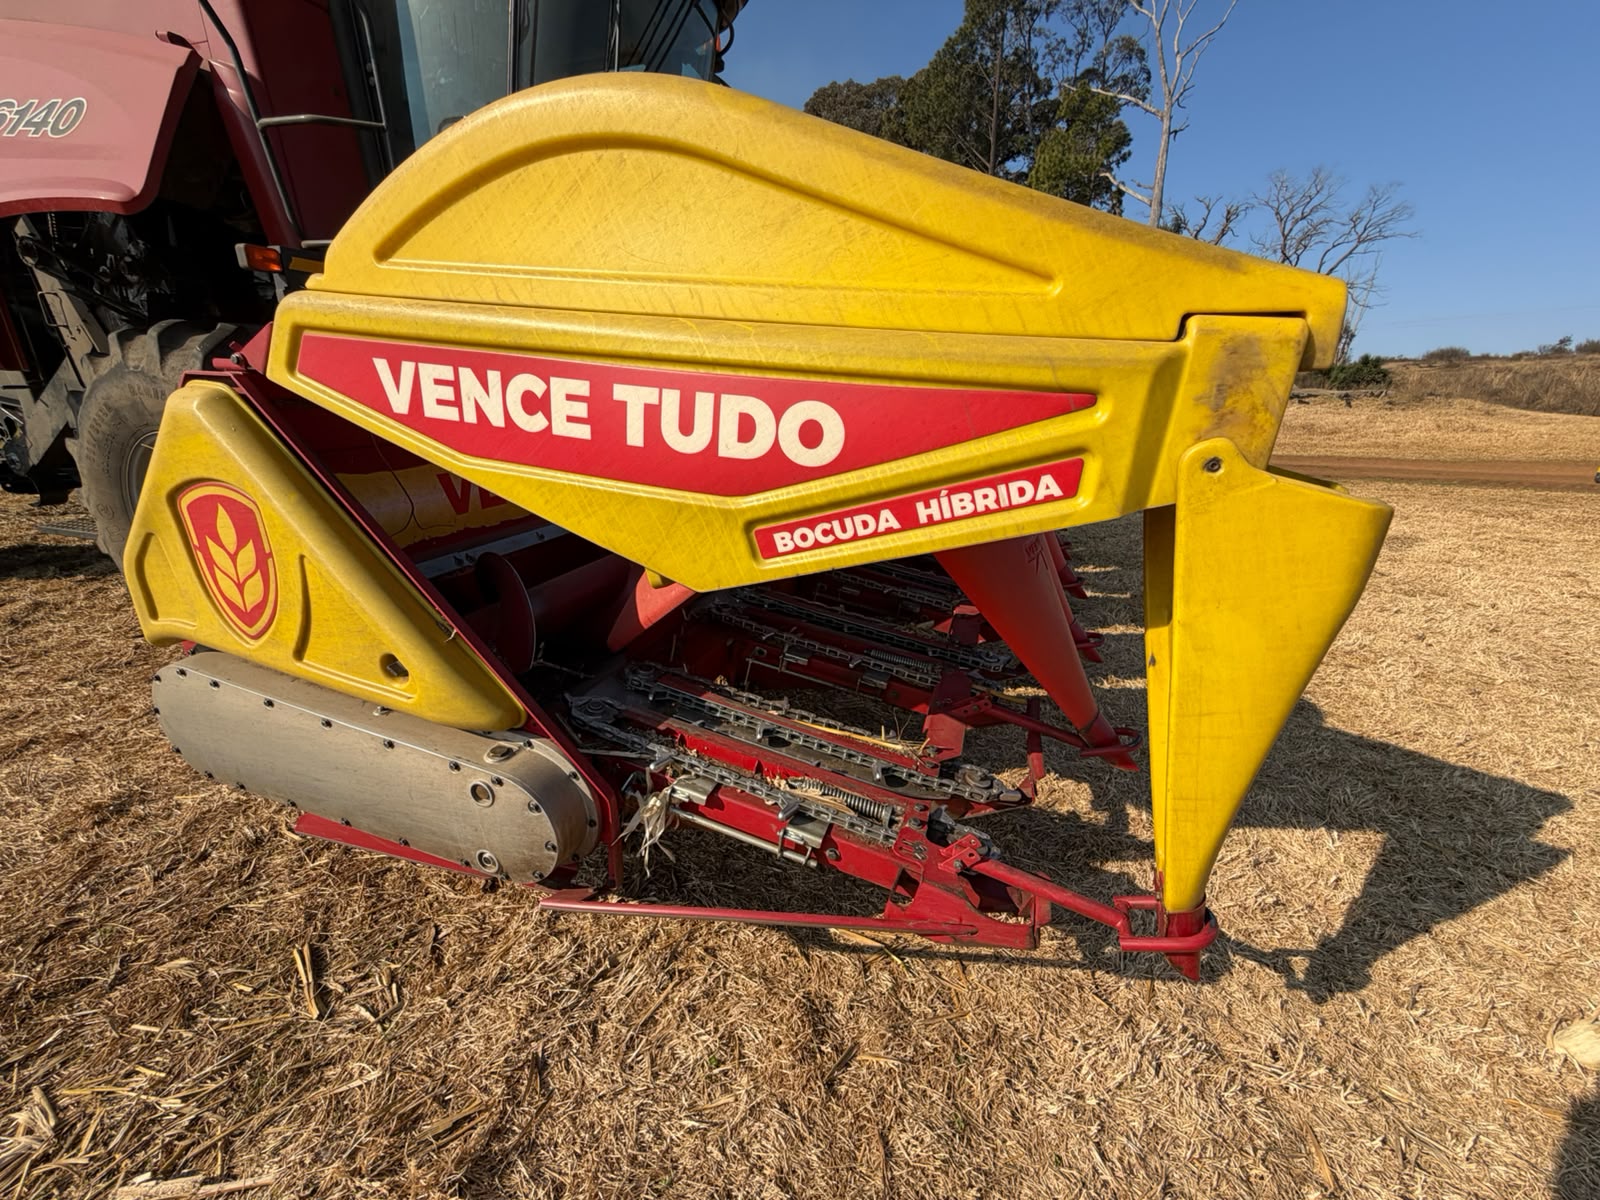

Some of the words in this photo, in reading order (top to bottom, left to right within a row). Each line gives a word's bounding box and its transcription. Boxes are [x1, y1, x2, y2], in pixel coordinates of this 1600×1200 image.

[372, 357, 592, 440] VENCE
[613, 383, 846, 467] TUDO
[772, 508, 901, 553] BOCUDA
[915, 474, 1063, 524] HÍBRIDA
